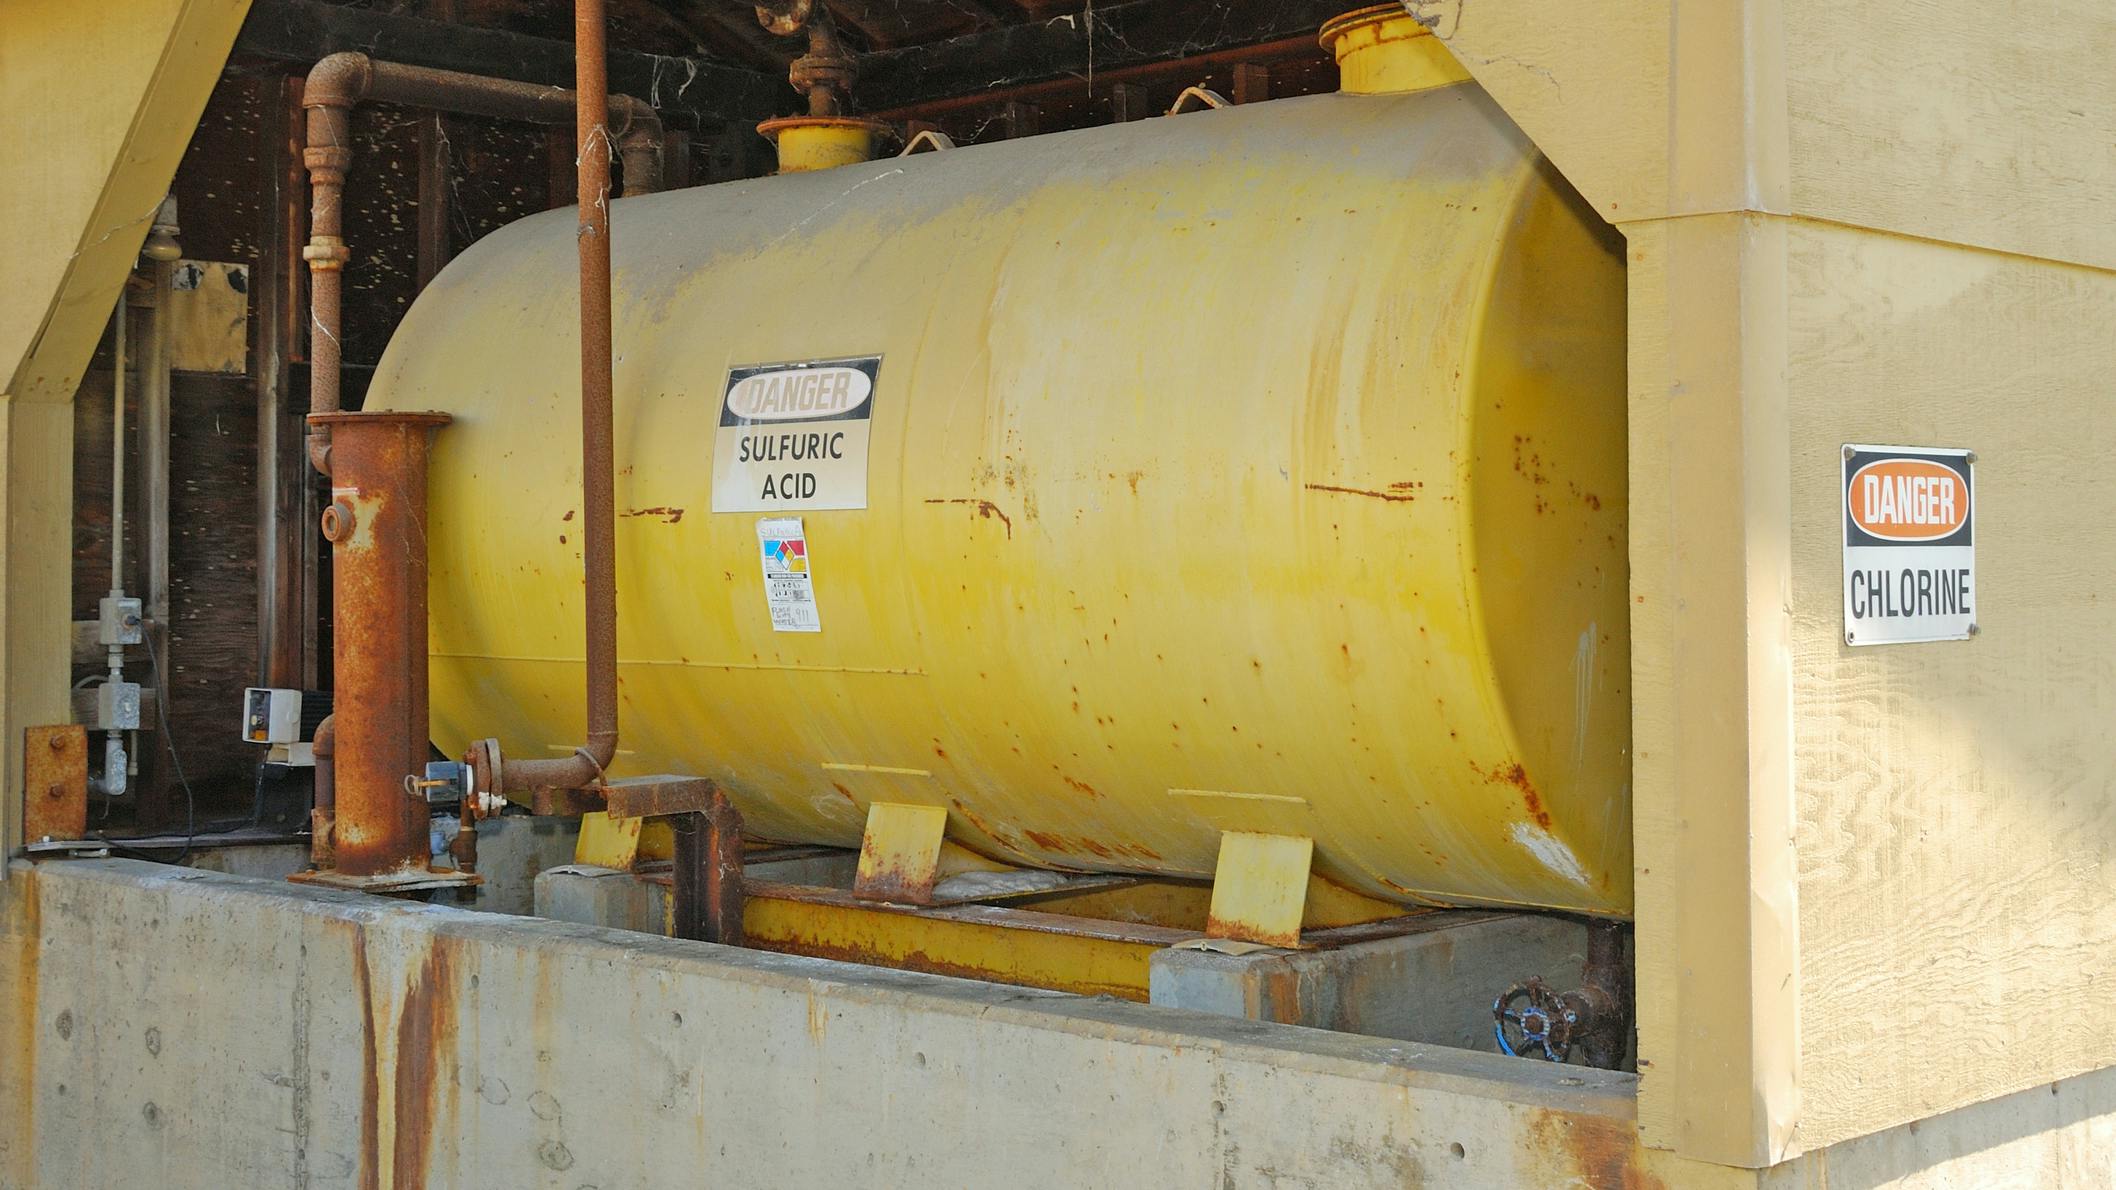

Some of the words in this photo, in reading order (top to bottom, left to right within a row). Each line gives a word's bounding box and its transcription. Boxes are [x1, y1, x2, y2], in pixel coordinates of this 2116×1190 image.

[745, 371, 851, 414] DANGER
[739, 432, 844, 463] SULFURIC
[761, 472, 816, 500] ACID
[1864, 475, 1956, 525] DANGER
[1851, 568, 1971, 619] CHLORINE
